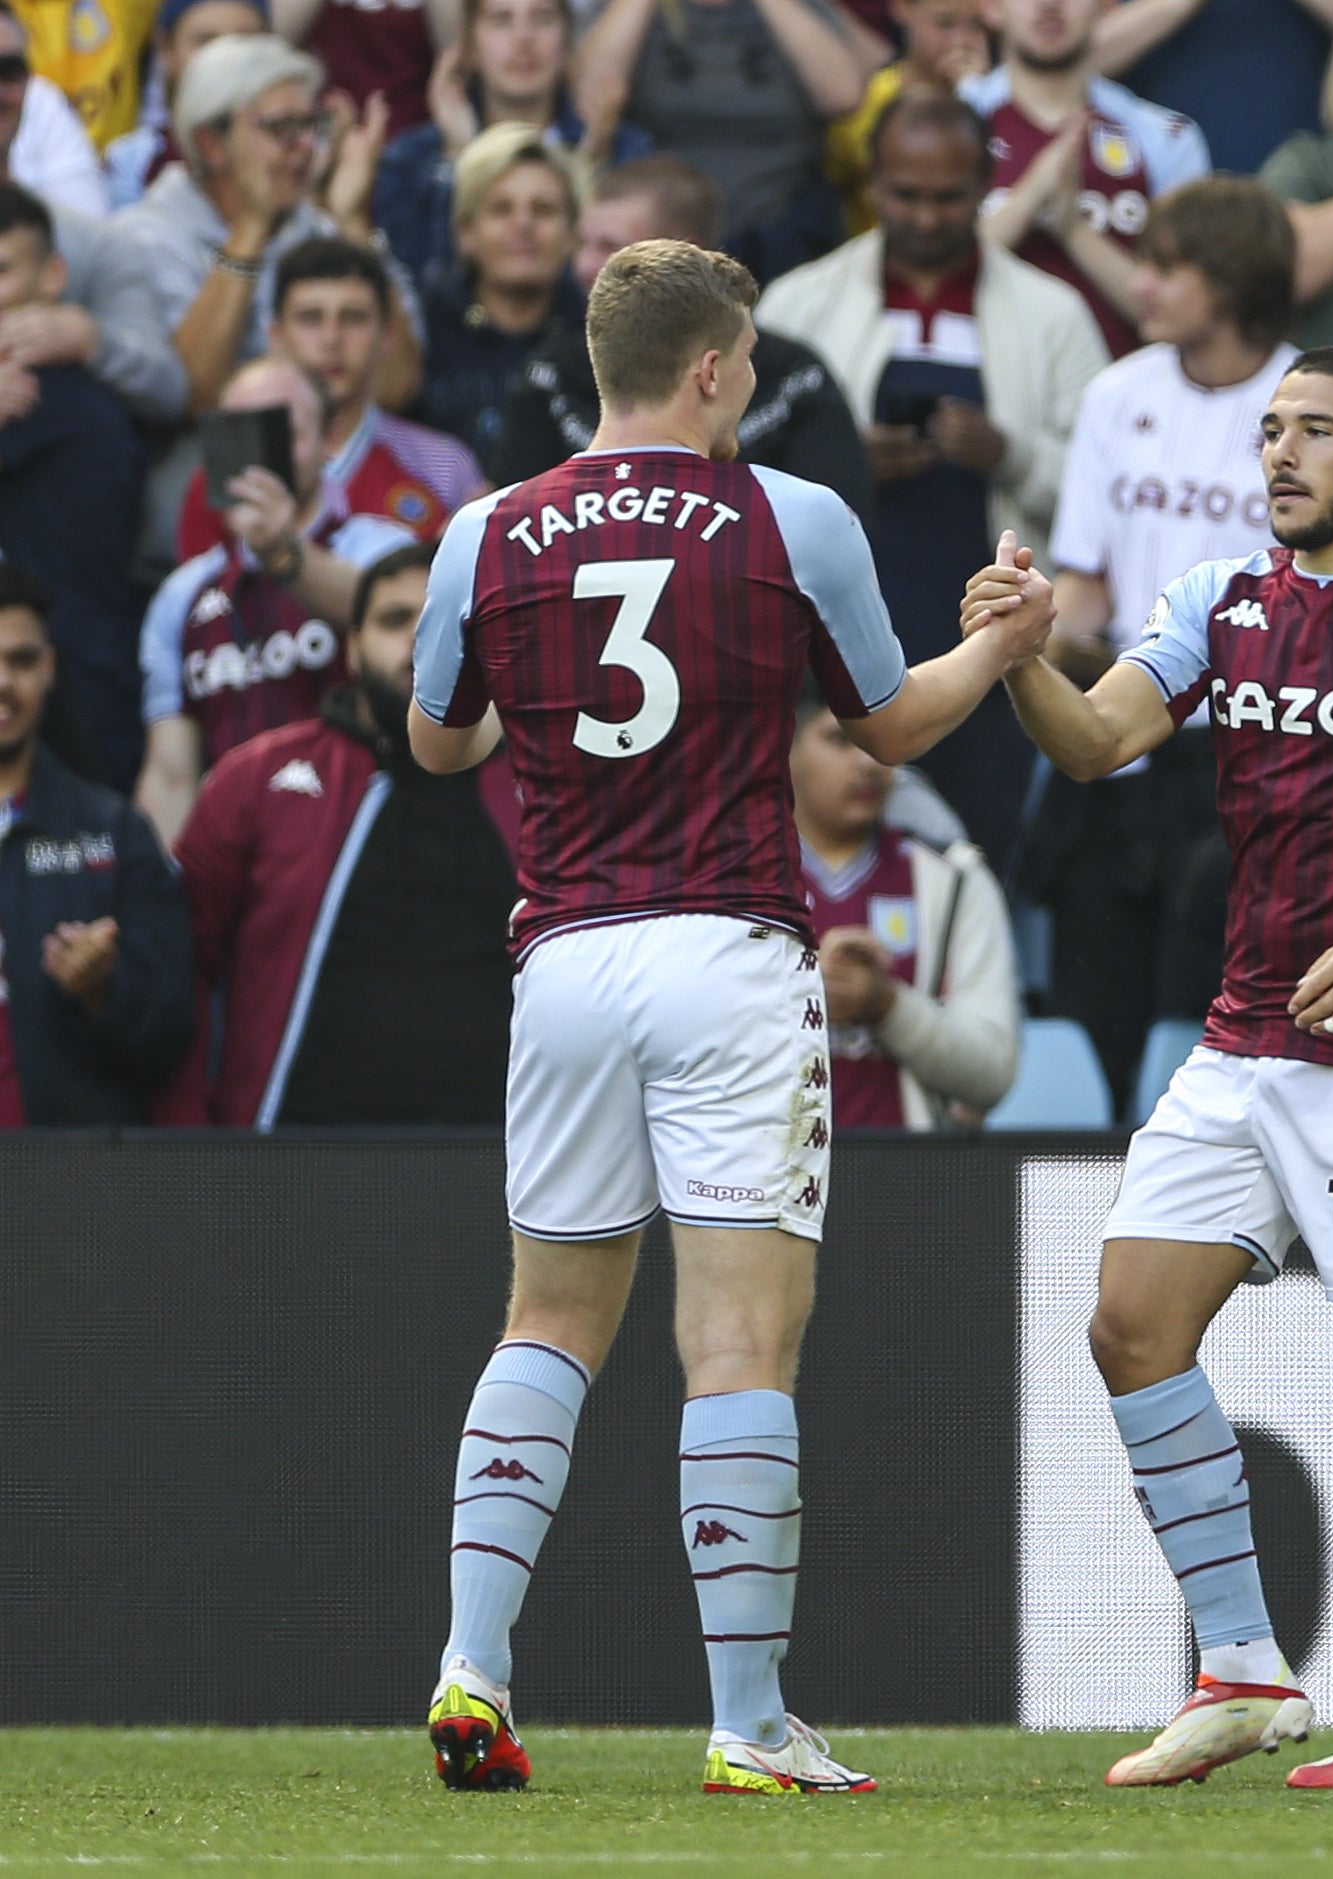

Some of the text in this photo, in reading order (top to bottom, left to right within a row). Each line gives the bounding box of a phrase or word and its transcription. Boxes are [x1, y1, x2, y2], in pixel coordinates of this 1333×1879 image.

[506, 486, 741, 556] TARGETT
[572, 558, 681, 759] 3
[687, 1180, 764, 1202] Kappa
